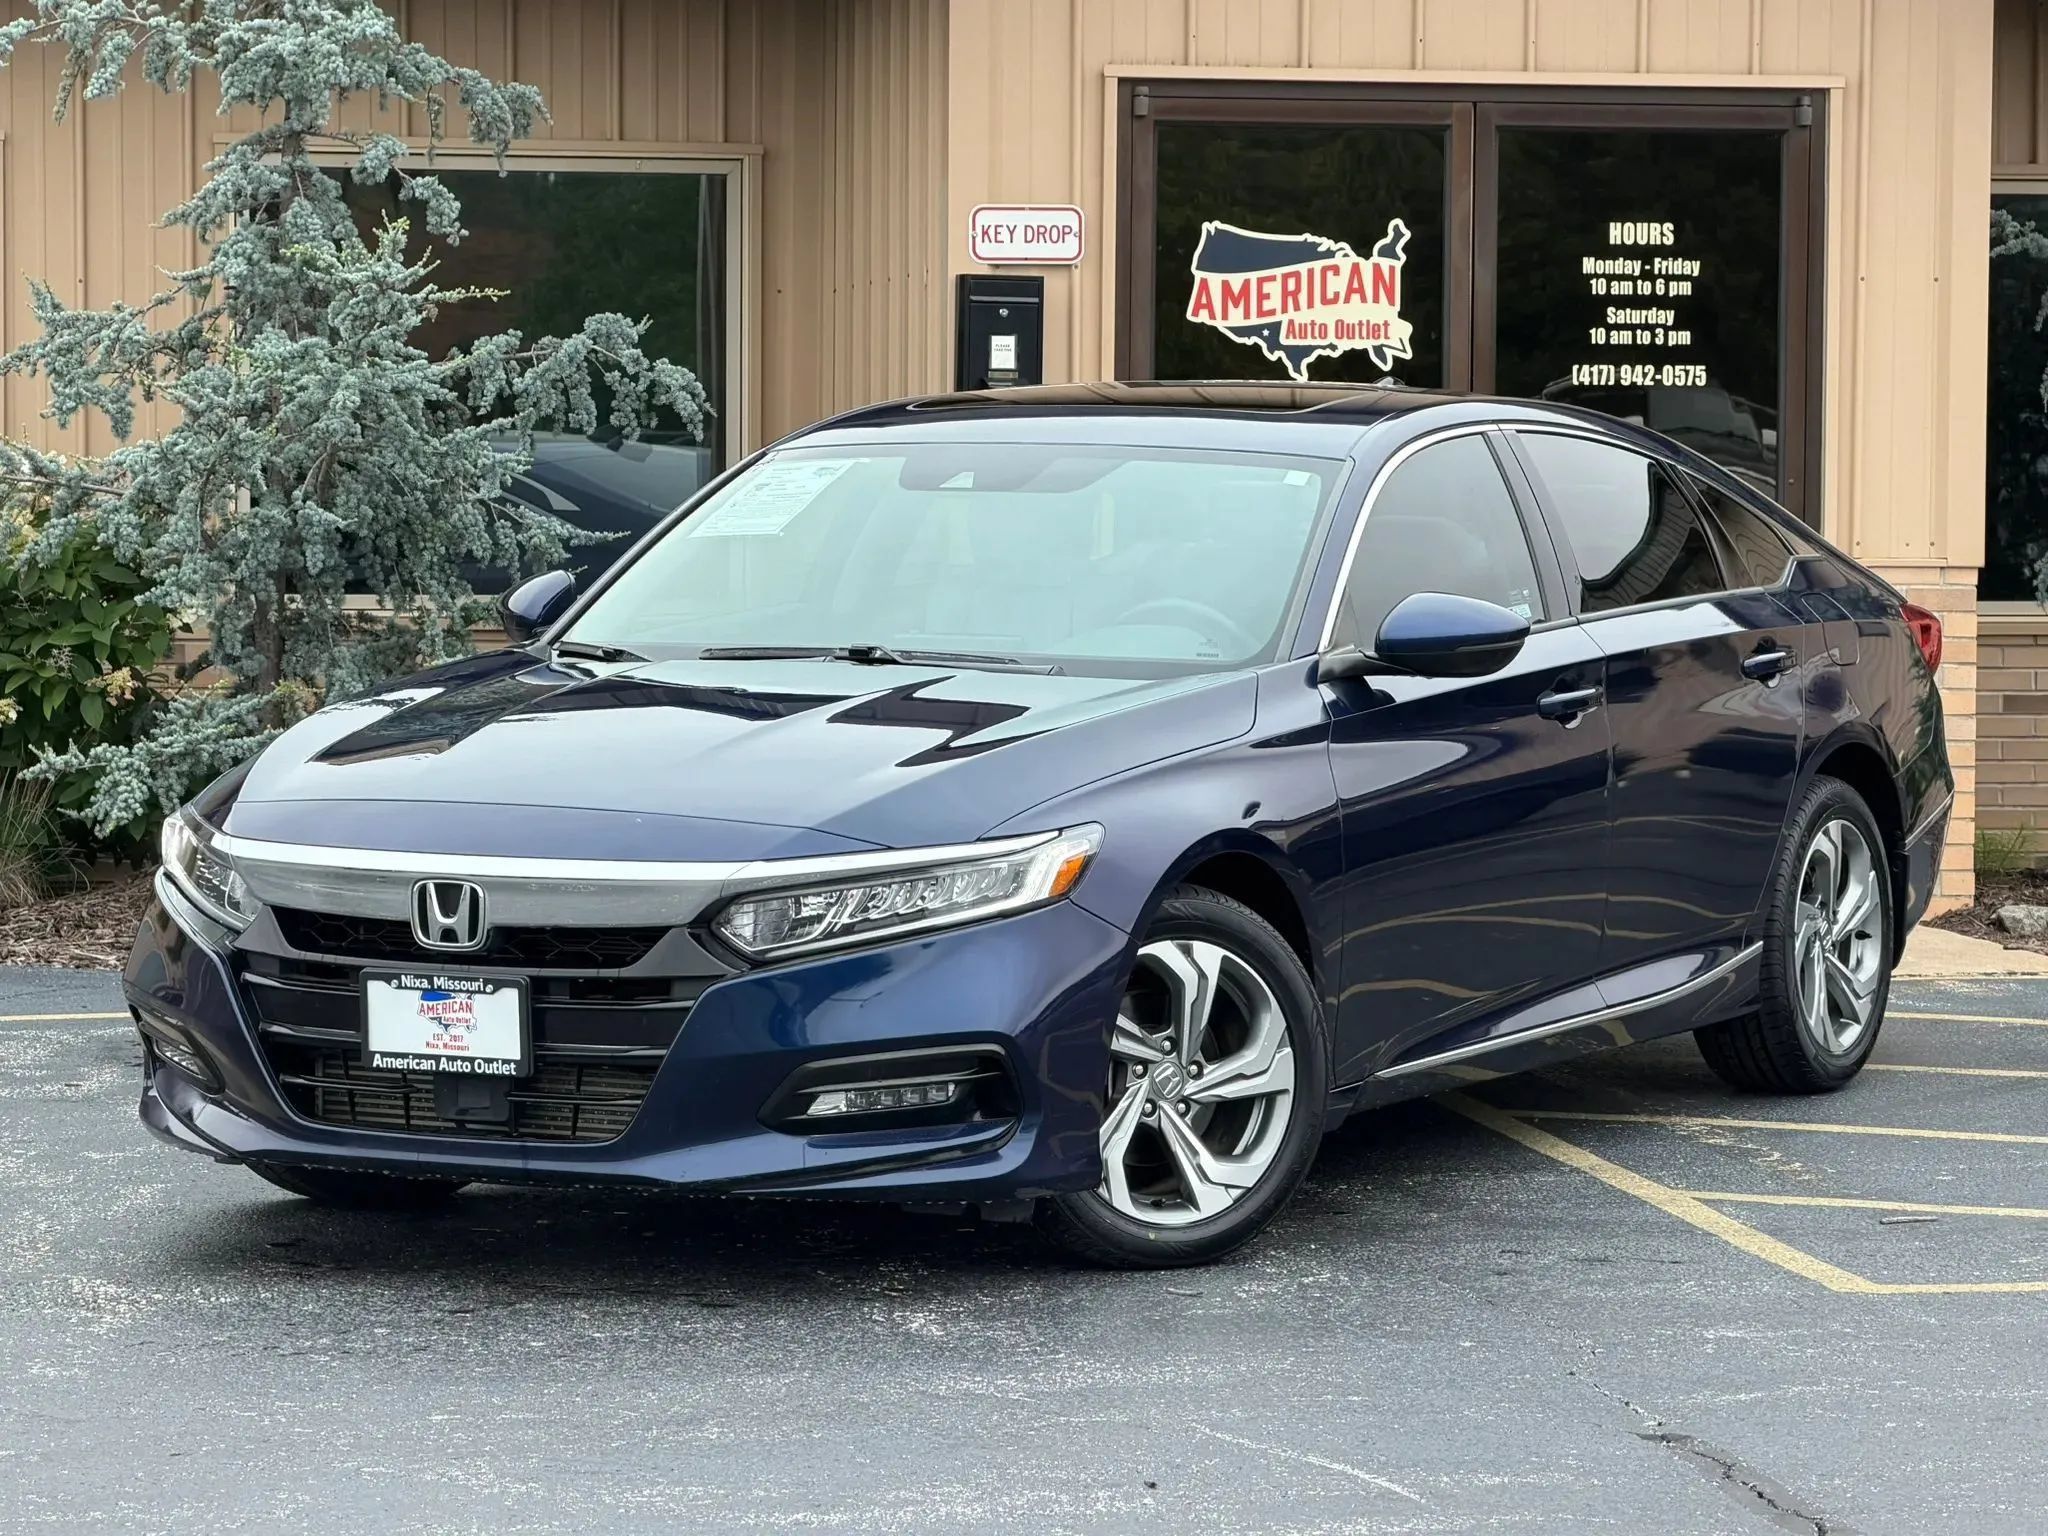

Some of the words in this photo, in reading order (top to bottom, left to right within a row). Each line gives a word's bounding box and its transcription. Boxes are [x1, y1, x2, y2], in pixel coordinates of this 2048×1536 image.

[981, 224, 1017, 244] KEY
[1023, 224, 1073, 244] DROP
[1609, 222, 1675, 245] HOURS
[1582, 256, 1642, 277] Monday
[1653, 257, 1701, 277] Friday
[1190, 261, 1396, 321] AMERICAN
[1589, 278, 1607, 295] 10
[1610, 281, 1633, 295] am
[1636, 279, 1652, 295] to
[1655, 278, 1665, 295] 6
[1668, 281, 1692, 297] pm
[1606, 306, 1675, 326] Saturday
[1285, 318, 1328, 340] Auto
[1334, 318, 1391, 341] Outlet
[1588, 327, 1606, 344] 10
[1609, 330, 1632, 345] am
[1635, 328, 1651, 345] to
[1654, 328, 1664, 345] 3
[1667, 331, 1691, 347] pm
[1572, 364, 1615, 386] (417)
[1620, 364, 1707, 387] 942-0575
[401, 974, 431, 989] Nixa,
[433, 975, 484, 991] Missouri
[419, 1000, 473, 1016] AMERICAN
[432, 1033, 446, 1041] EST.
[449, 1034, 463, 1043] 2017
[442, 1042, 470, 1052] Missouri
[372, 1053, 436, 1071] American
[439, 1056, 472, 1073] Auto
[474, 1060, 517, 1075] Outlet
